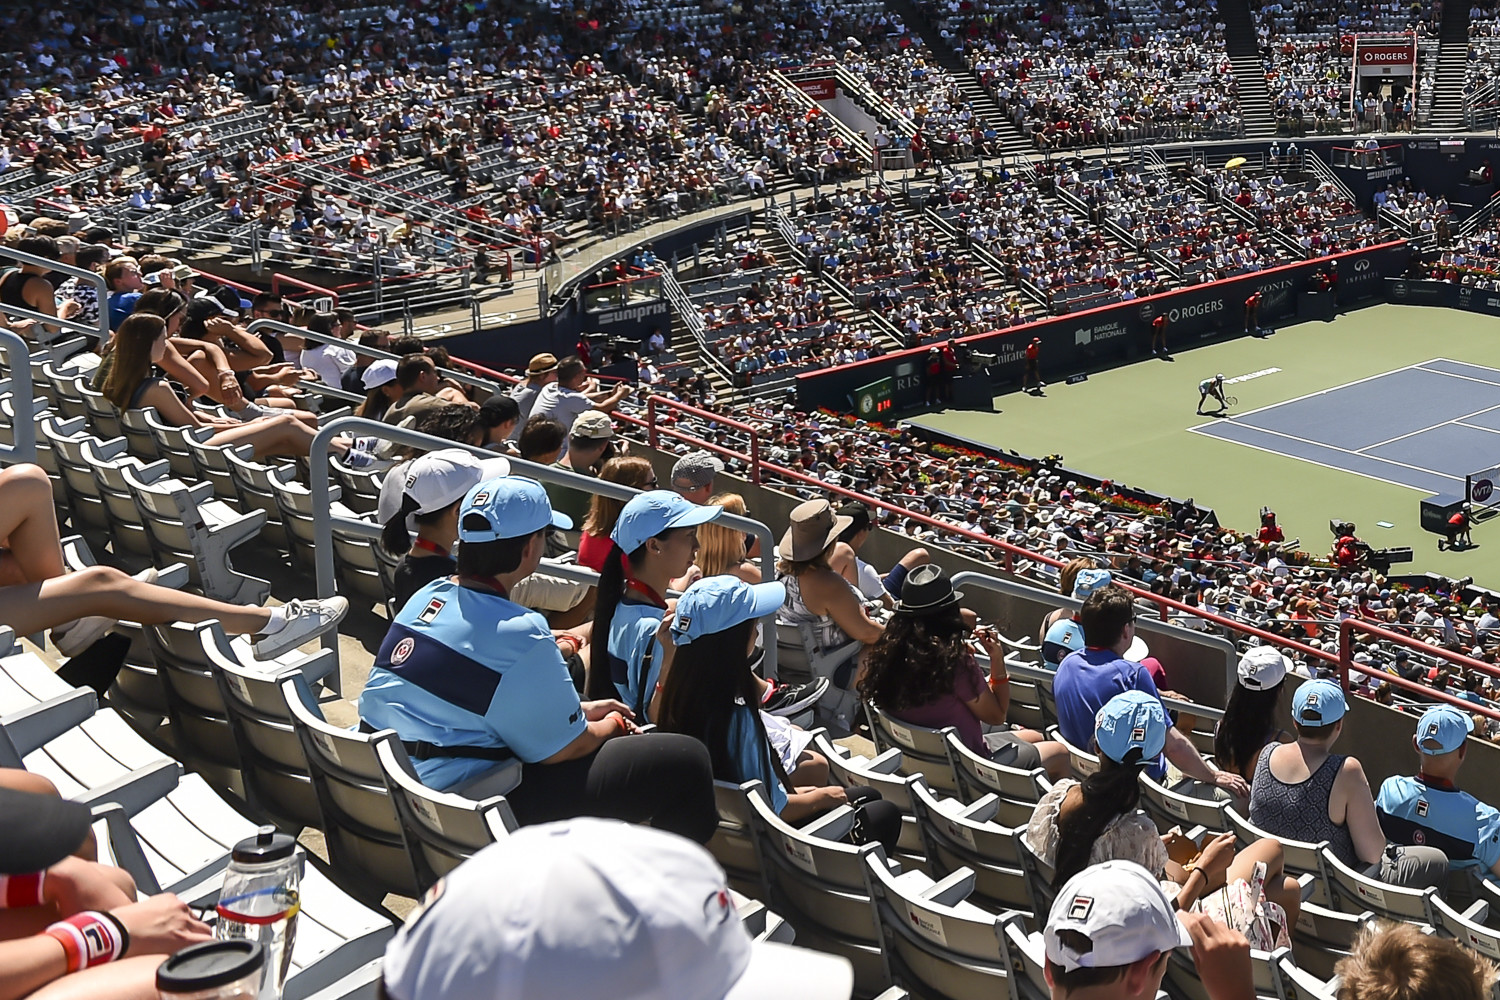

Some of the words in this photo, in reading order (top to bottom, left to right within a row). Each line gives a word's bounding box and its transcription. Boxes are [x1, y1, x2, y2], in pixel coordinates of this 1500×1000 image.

[1374, 52, 1408, 61] ROGERS
[1375, 166, 1403, 180] uniprix
[1346, 272, 1379, 285] INFINITI
[1257, 279, 1293, 294] ZONIN
[613, 302, 667, 323] uniprix
[1181, 299, 1223, 320] ROGERS
[1093, 322, 1119, 334] BANQUE
[1093, 327, 1126, 341] NATIONALE
[1473, 485, 1491, 498] WTA
